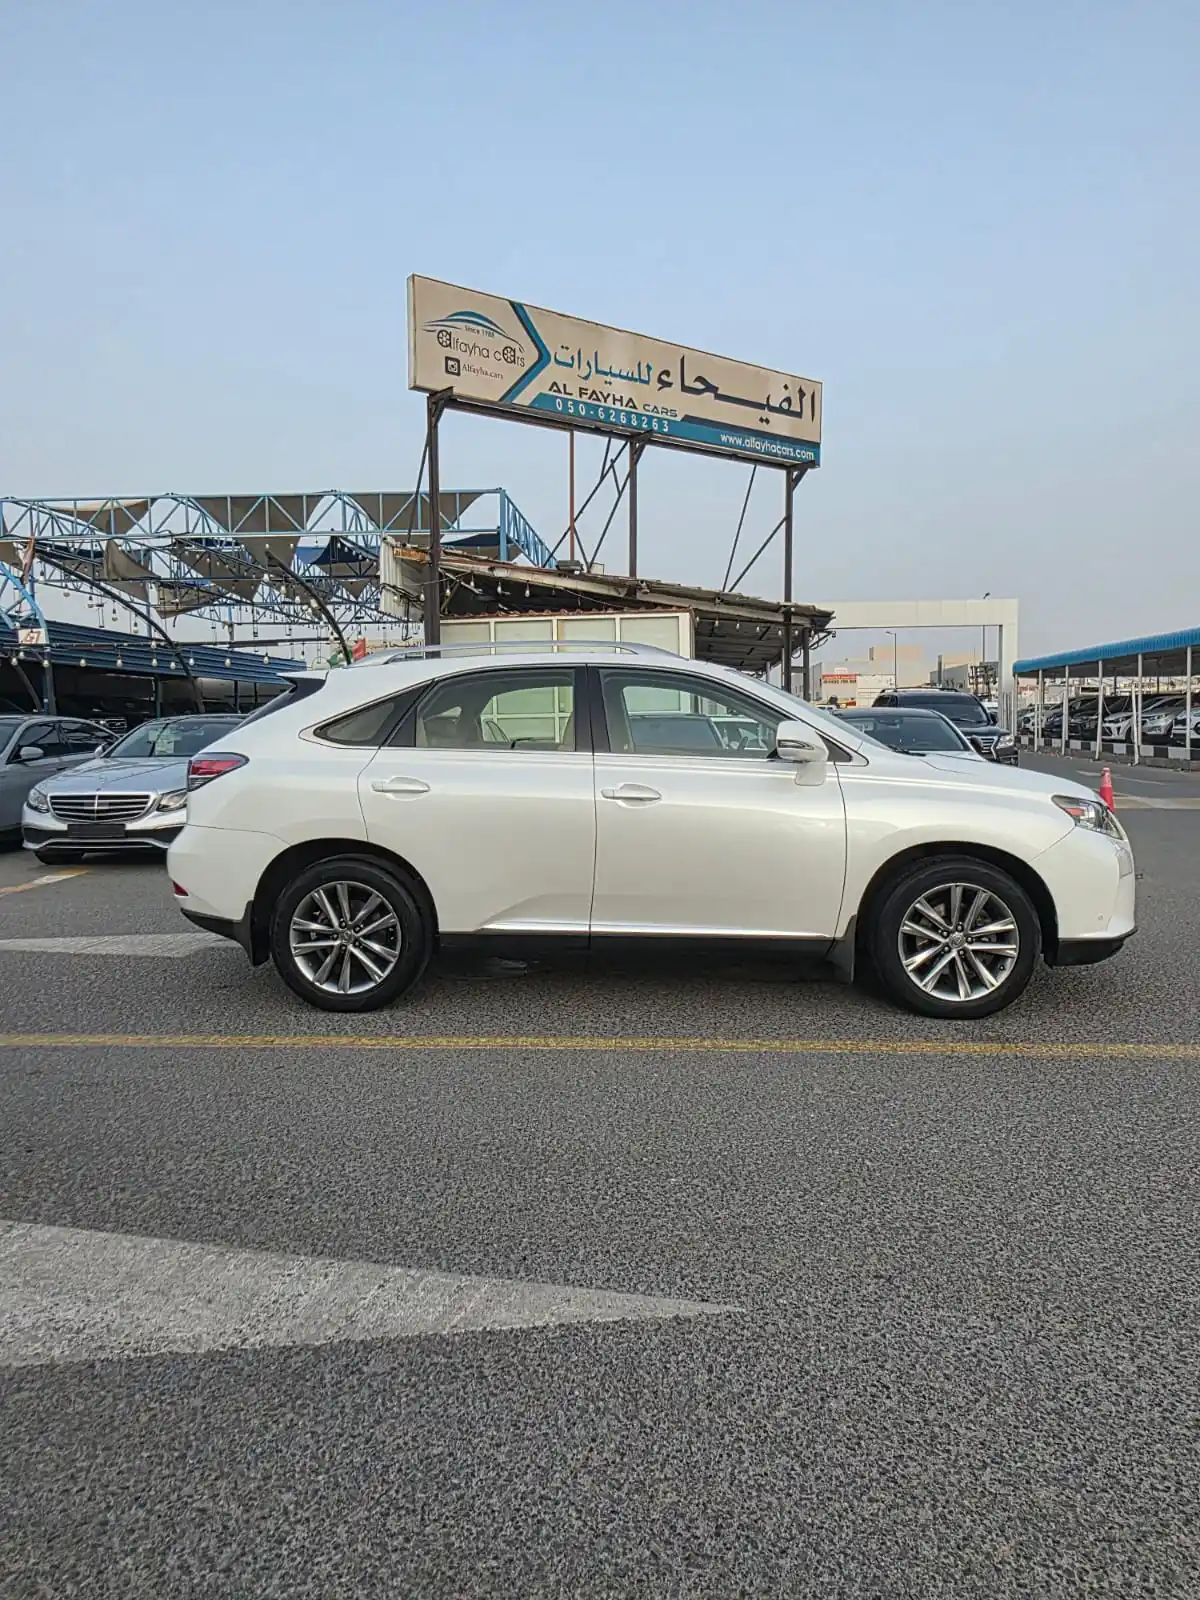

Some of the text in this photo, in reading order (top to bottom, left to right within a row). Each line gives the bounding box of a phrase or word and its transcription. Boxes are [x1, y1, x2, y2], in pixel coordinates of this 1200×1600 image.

[436, 329, 526, 368] alfayha cars
[548, 380, 678, 418] AL FAYHA CARS
[554, 345, 816, 424] الفيحاء للسيارات
[555, 398, 670, 433] 050-6268263
[720, 433, 815, 461] www.alfayhacars.com
